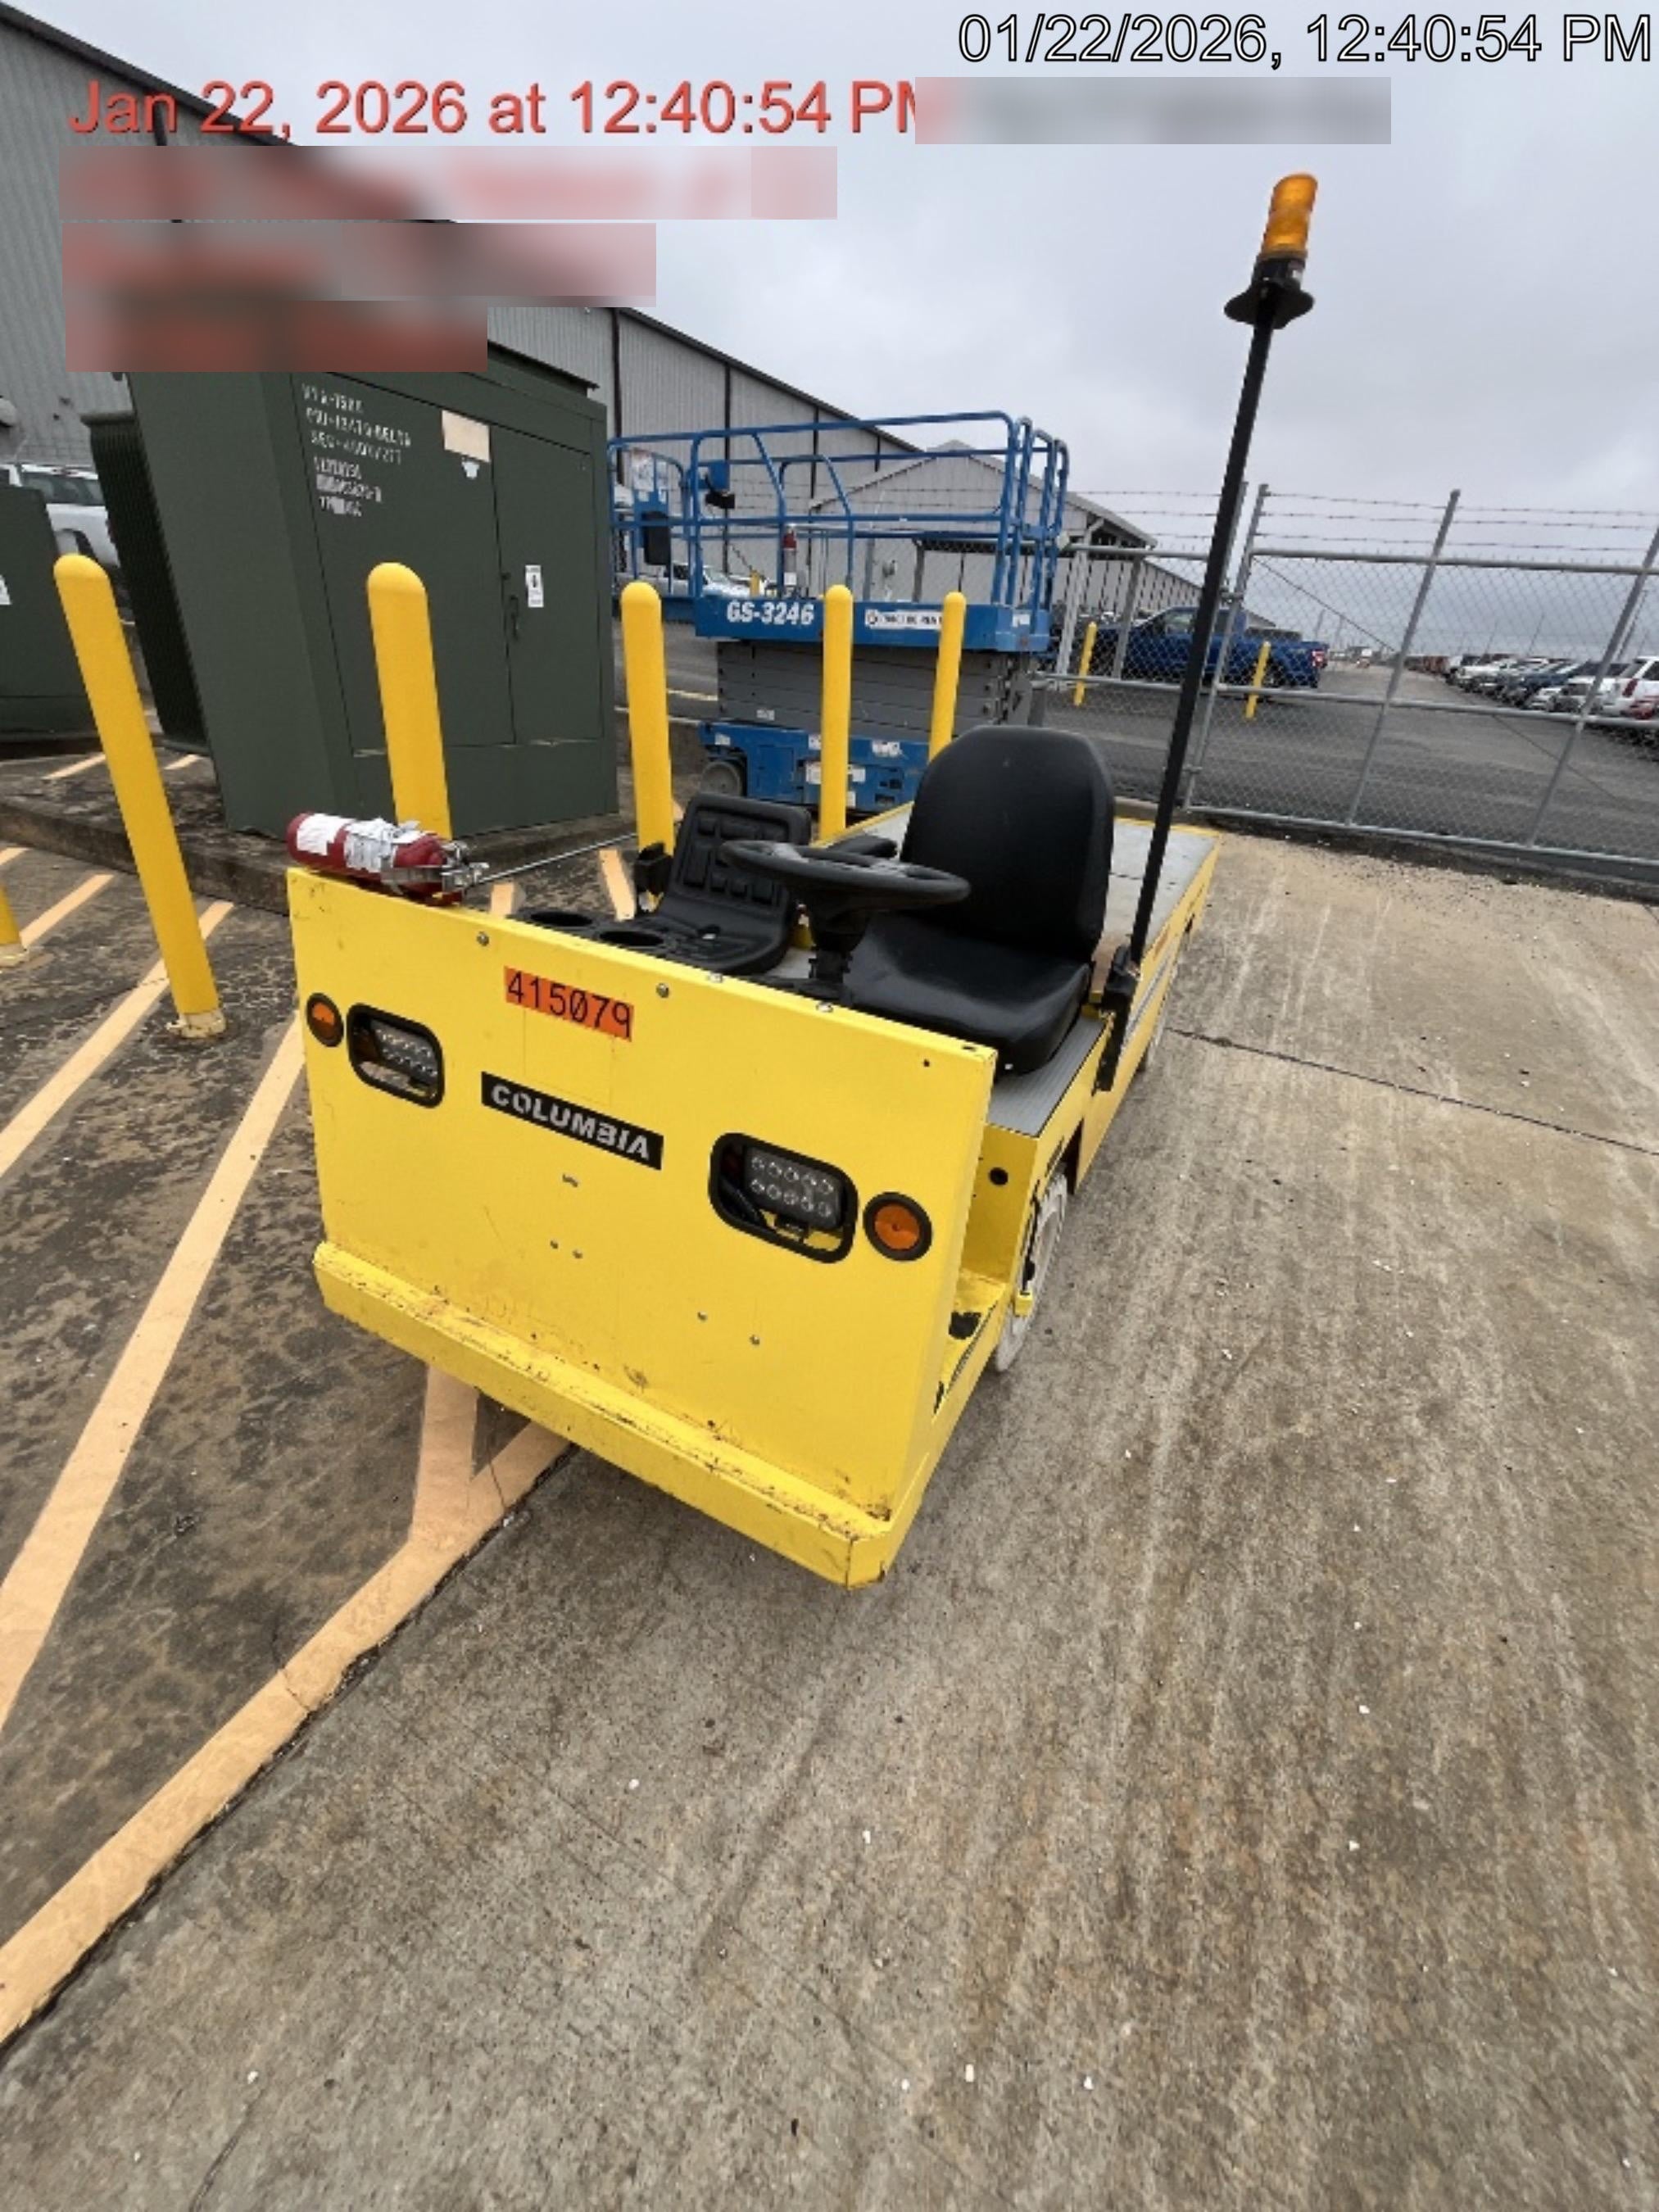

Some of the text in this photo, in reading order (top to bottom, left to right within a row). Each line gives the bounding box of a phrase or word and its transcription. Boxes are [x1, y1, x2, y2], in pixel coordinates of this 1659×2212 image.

[726, 600, 815, 626] GS-3246
[507, 970, 632, 1038] 415079
[492, 1082, 651, 1160] COLUMBIA
